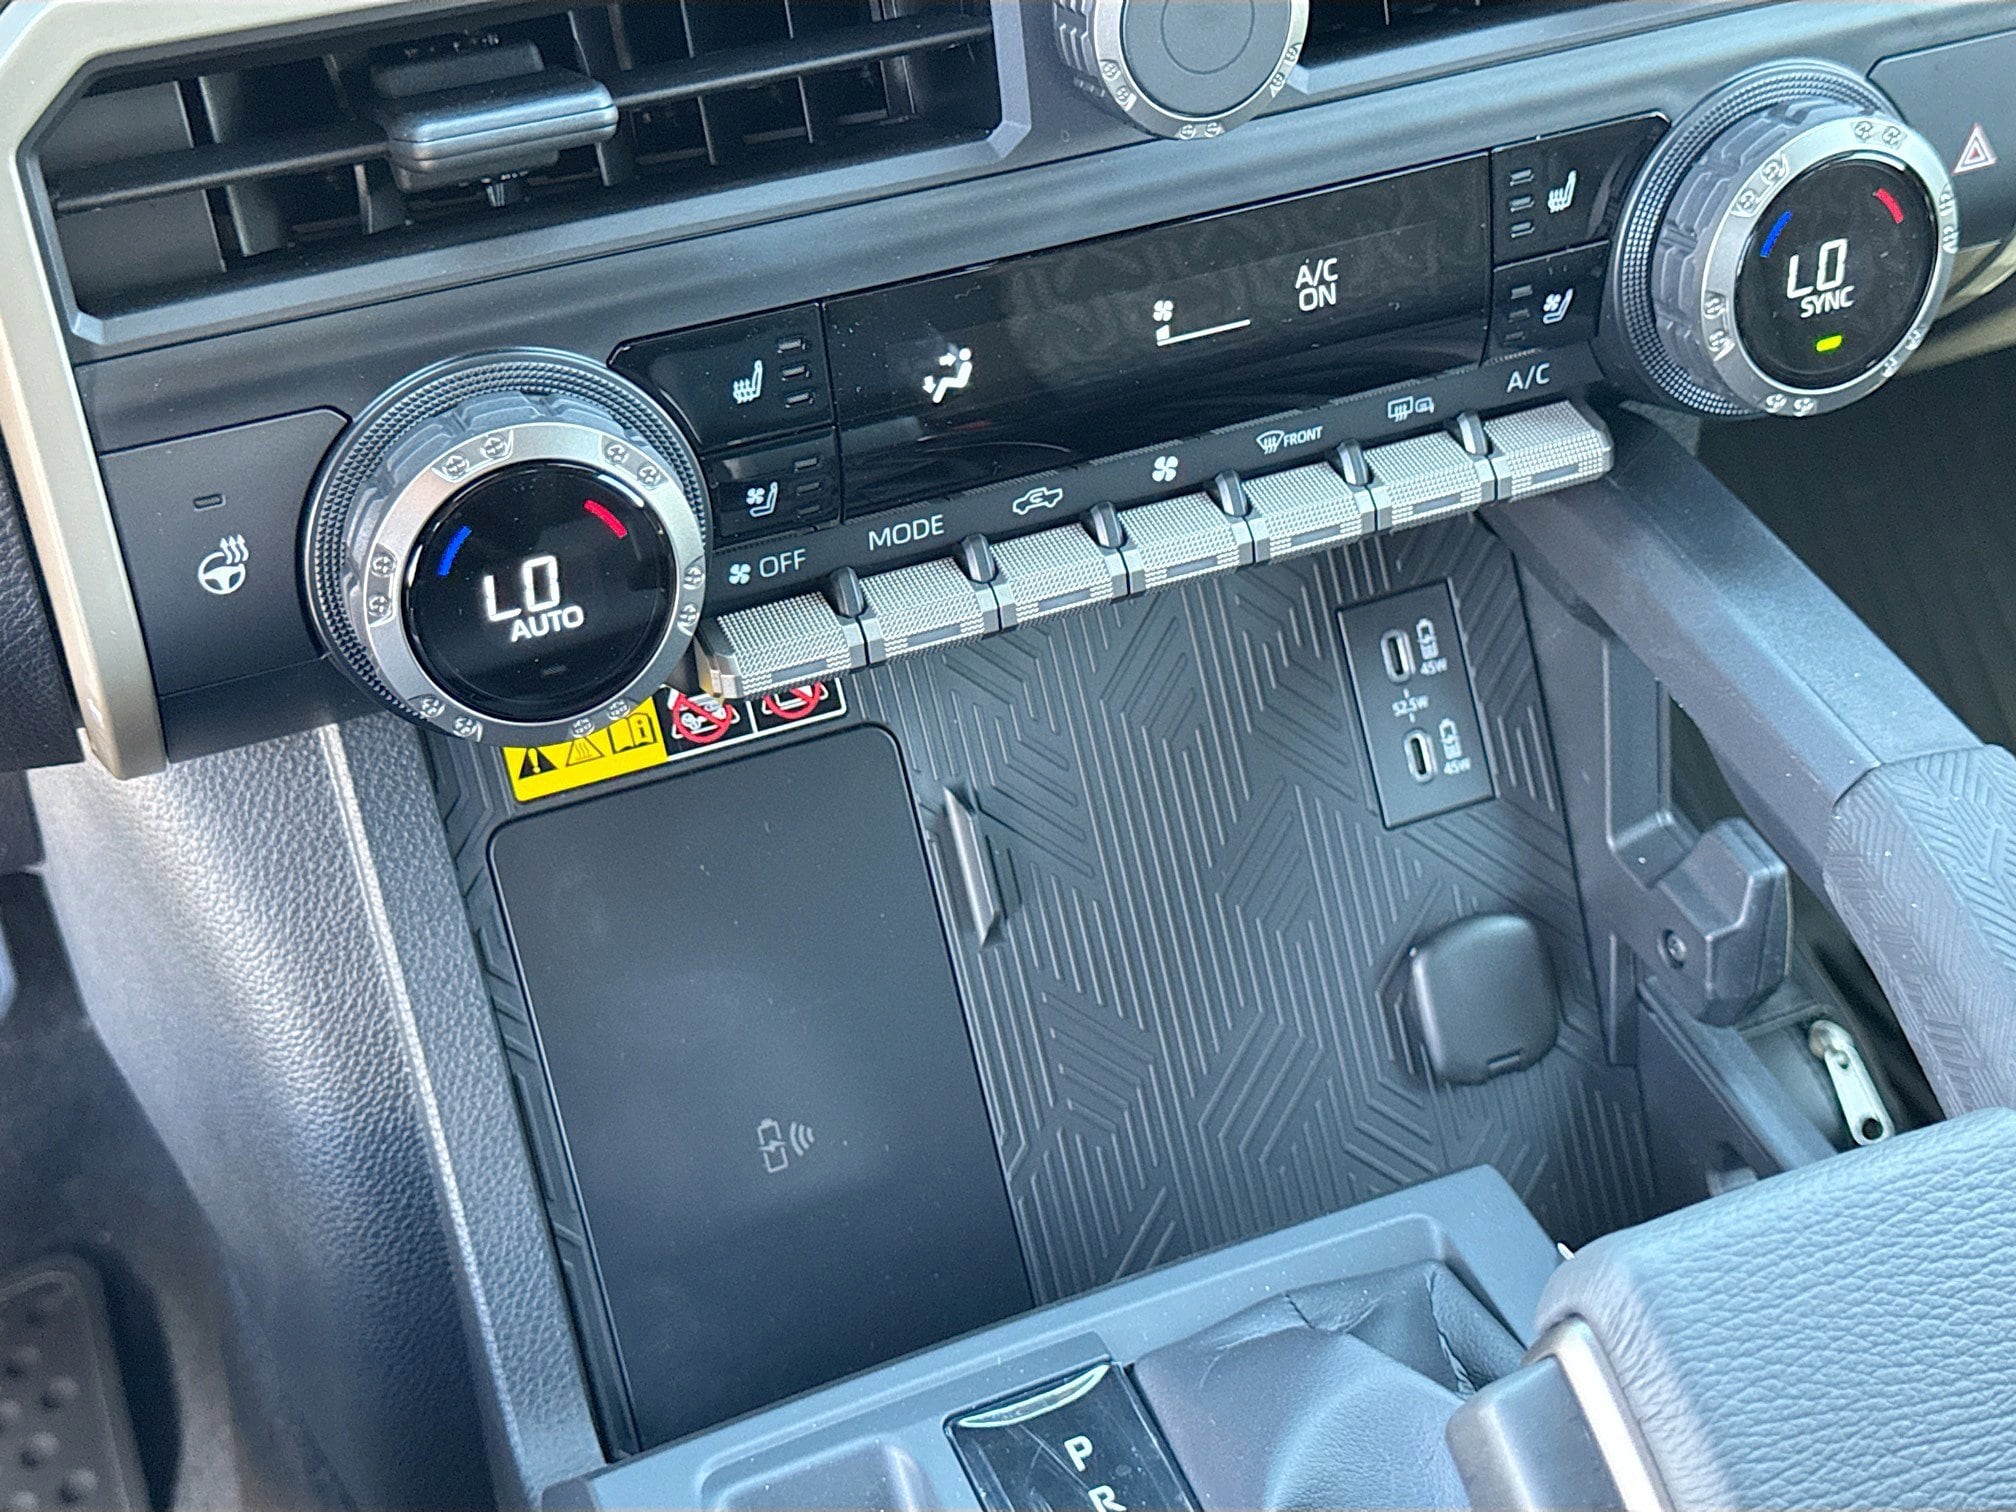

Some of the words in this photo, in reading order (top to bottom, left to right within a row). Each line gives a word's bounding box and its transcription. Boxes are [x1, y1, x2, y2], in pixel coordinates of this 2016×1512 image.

[1295, 257, 1338, 289] A/C
[1299, 282, 1337, 311] ON
[1800, 285, 1855, 318] SYNC
[1506, 362, 1550, 393] A/C
[1283, 425, 1323, 447] FRONT
[868, 513, 945, 551] MODE
[759, 548, 806, 578] OFF
[511, 605, 584, 642] AUTO
[1420, 657, 1448, 677] 45W
[1443, 757, 1472, 776] 45W
[1064, 1435, 1093, 1472] P
[1088, 1485, 1127, 1512] R
